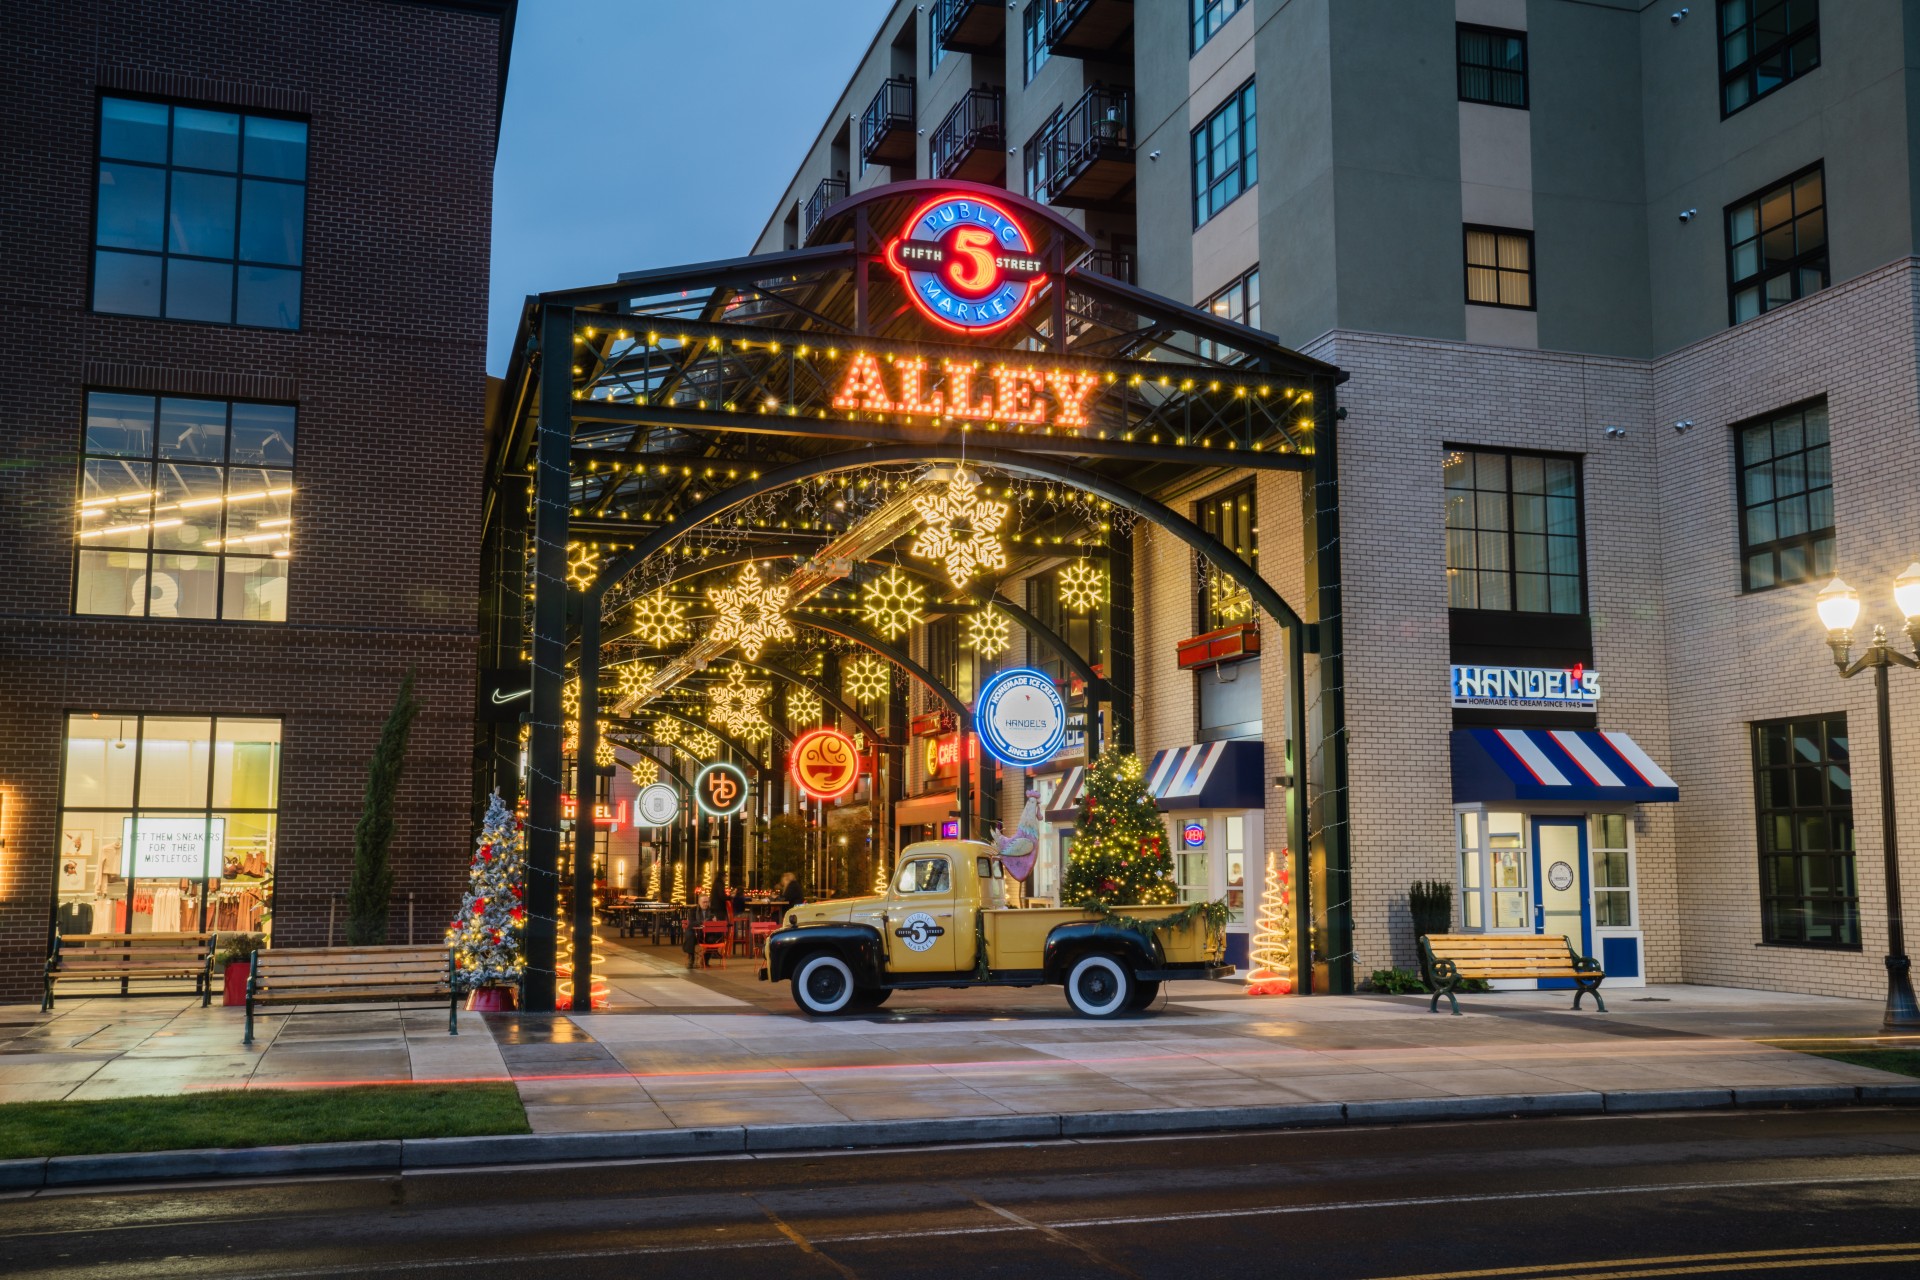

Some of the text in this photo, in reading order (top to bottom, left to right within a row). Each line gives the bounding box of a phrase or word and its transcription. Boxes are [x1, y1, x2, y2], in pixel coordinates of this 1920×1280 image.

[923, 202, 1017, 243] PUBLIC
[903, 247, 1041, 271] FIFTH STREET
[951, 230, 996, 290] 5
[920, 280, 1018, 321] MARKET
[832, 355, 1099, 427] ALLEY
[992, 677, 1061, 707] HOMEMADE ICE CREAM
[1468, 698, 1508, 706] HOMEMADE
[1519, 699, 1543, 707] CREAM
[1005, 719, 1047, 728] HANDEL'S
[1007, 745, 1028, 757] SINCE
[1029, 746, 1045, 757] 1945
[565, 805, 611, 818] HEL
[151, 833, 172, 841] THEM
[1185, 829, 1205, 841] OPEN
[149, 844, 196, 852] FOR THEIR
[144, 855, 198, 863] MISTLETOES
[911, 922, 927, 944] 5
[907, 940, 933, 951] MARKET
